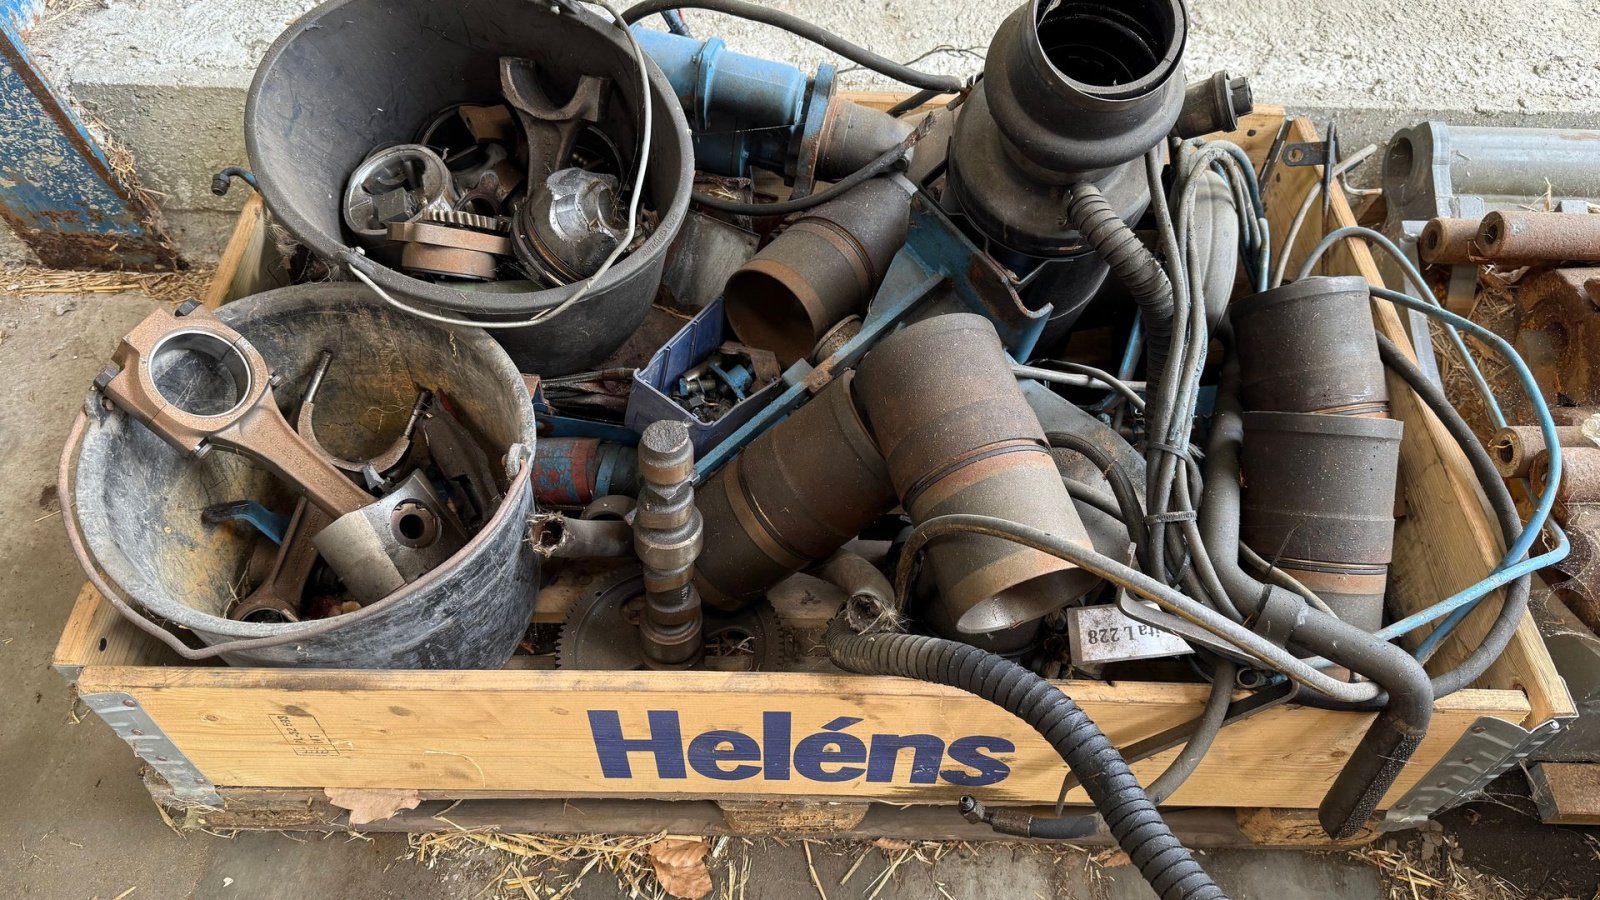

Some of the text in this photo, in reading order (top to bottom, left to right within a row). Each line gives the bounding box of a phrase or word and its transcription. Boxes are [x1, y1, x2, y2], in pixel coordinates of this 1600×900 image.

[1087, 627, 1120, 645] 228
[1123, 625, 1136, 641] L
[587, 709, 1016, 787] Heléns
